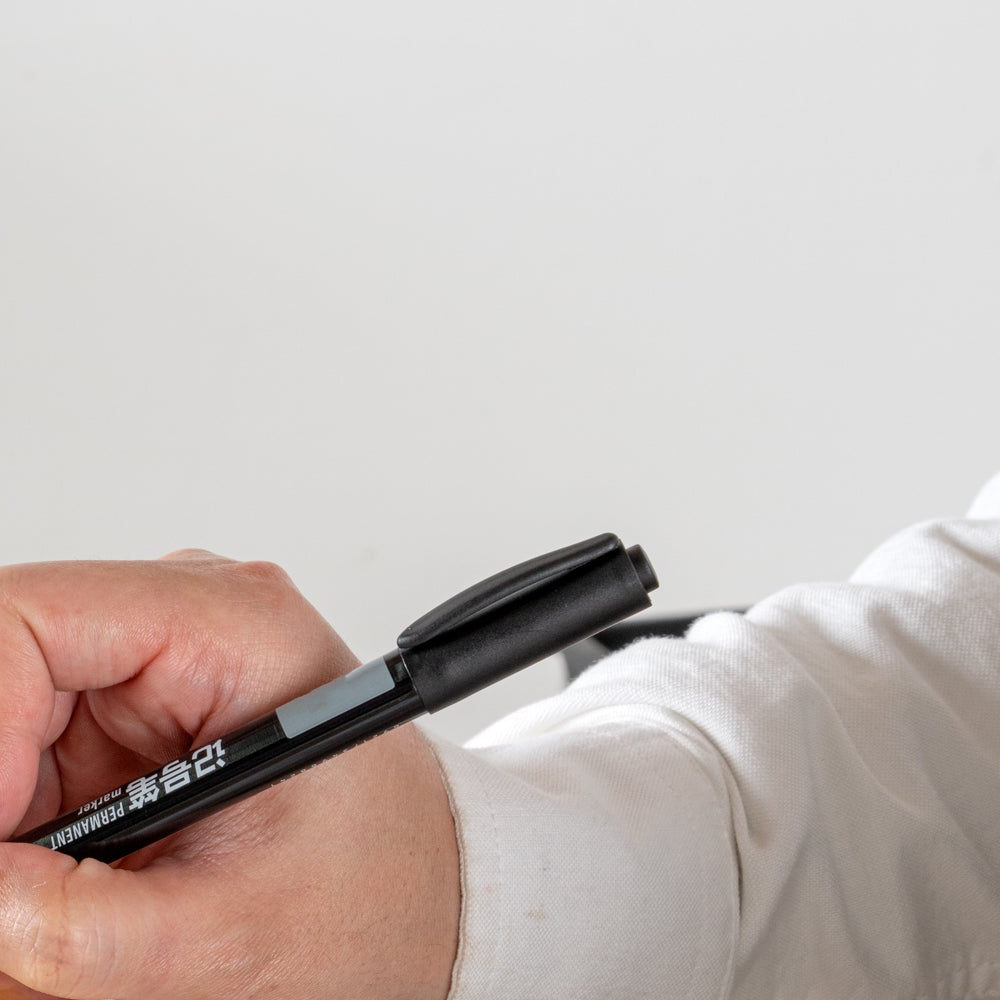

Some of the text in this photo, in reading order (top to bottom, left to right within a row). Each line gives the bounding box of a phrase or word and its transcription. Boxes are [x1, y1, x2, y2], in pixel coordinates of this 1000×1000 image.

[126, 739, 226, 811] 记号笔
[50, 802, 125, 851] PERMANENT
[77, 788, 122, 816] marker
